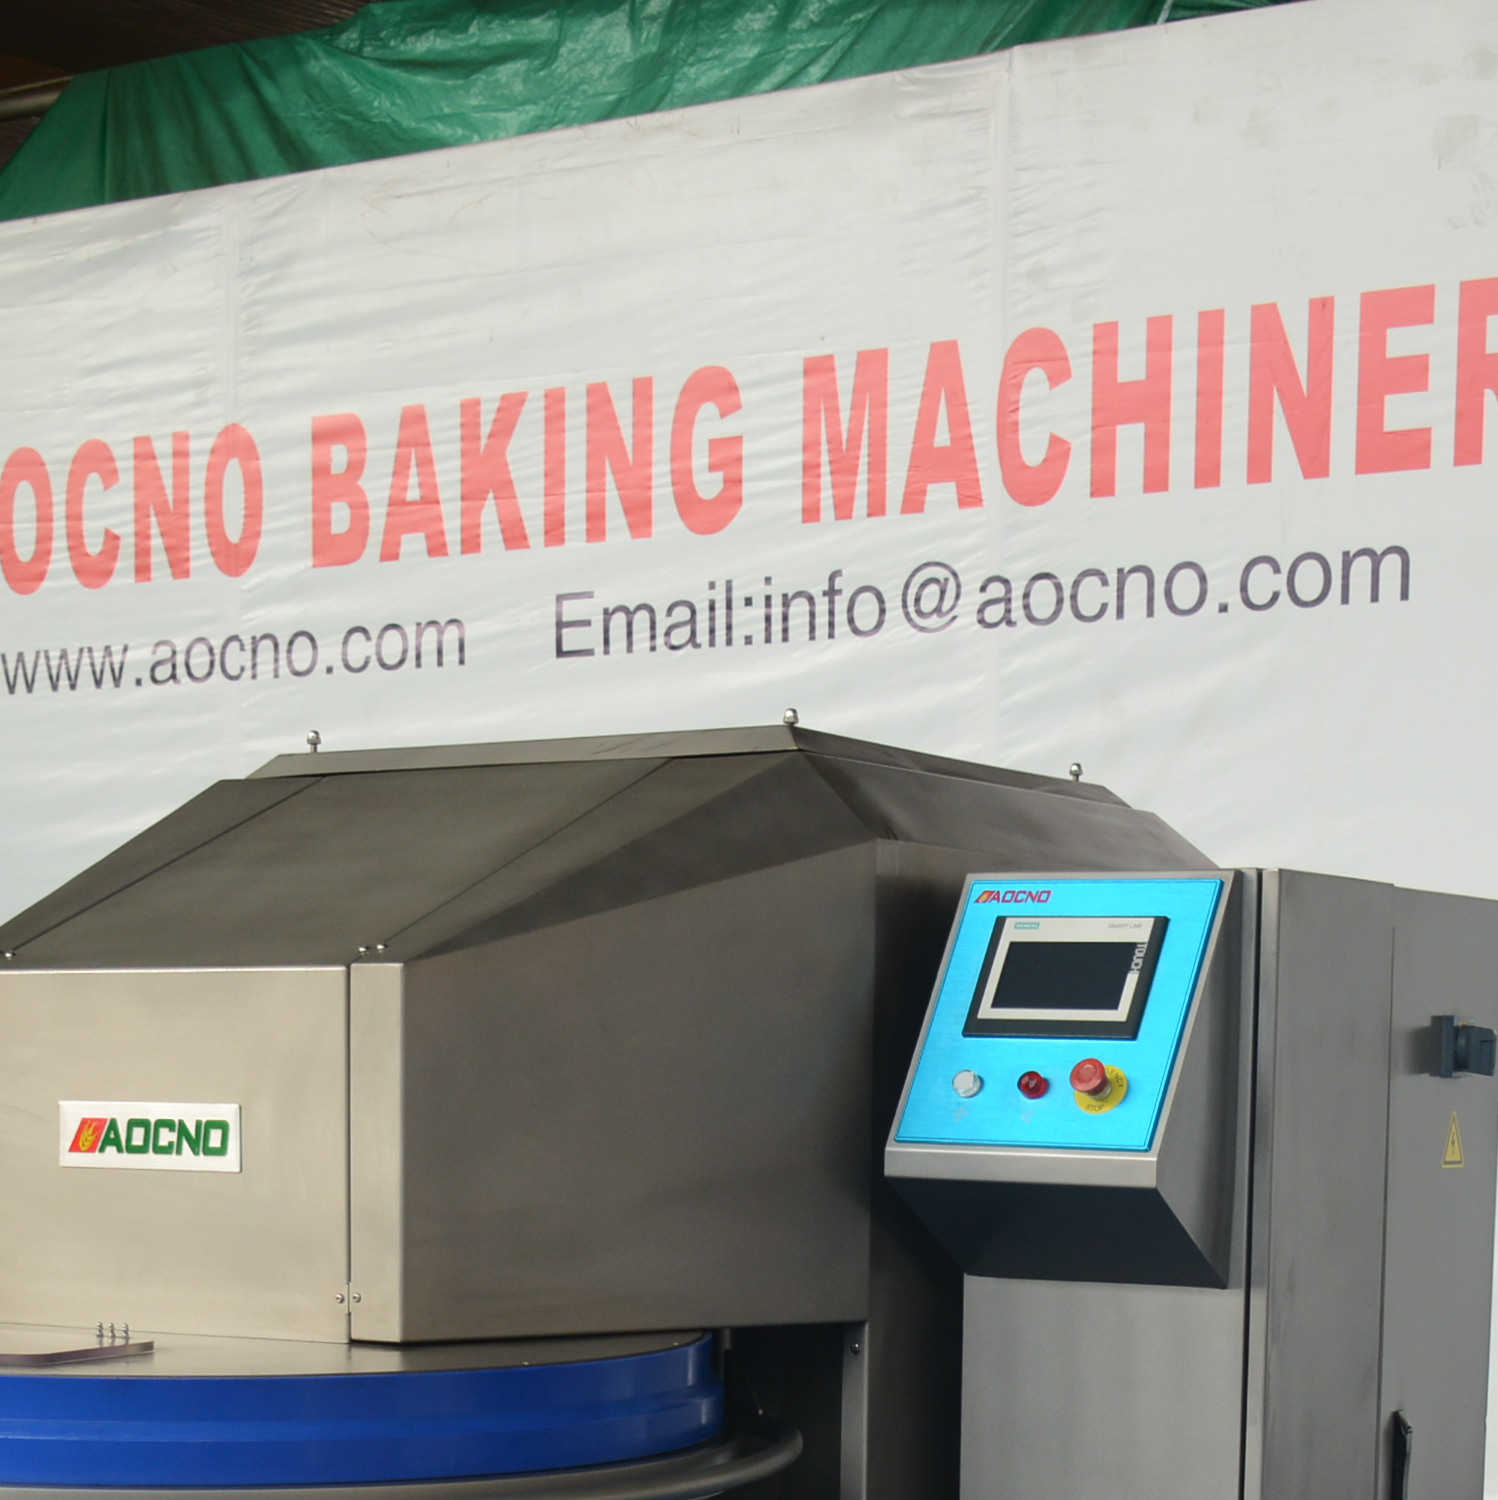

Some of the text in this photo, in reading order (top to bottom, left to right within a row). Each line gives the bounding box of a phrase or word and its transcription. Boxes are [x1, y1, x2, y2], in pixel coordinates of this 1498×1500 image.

[311, 365, 744, 569] BAKING
[0, 616, 467, 696] www.aocno.com
[989, 890, 1052, 904] AOCNO
[98, 1117, 231, 1157] AOCNO
